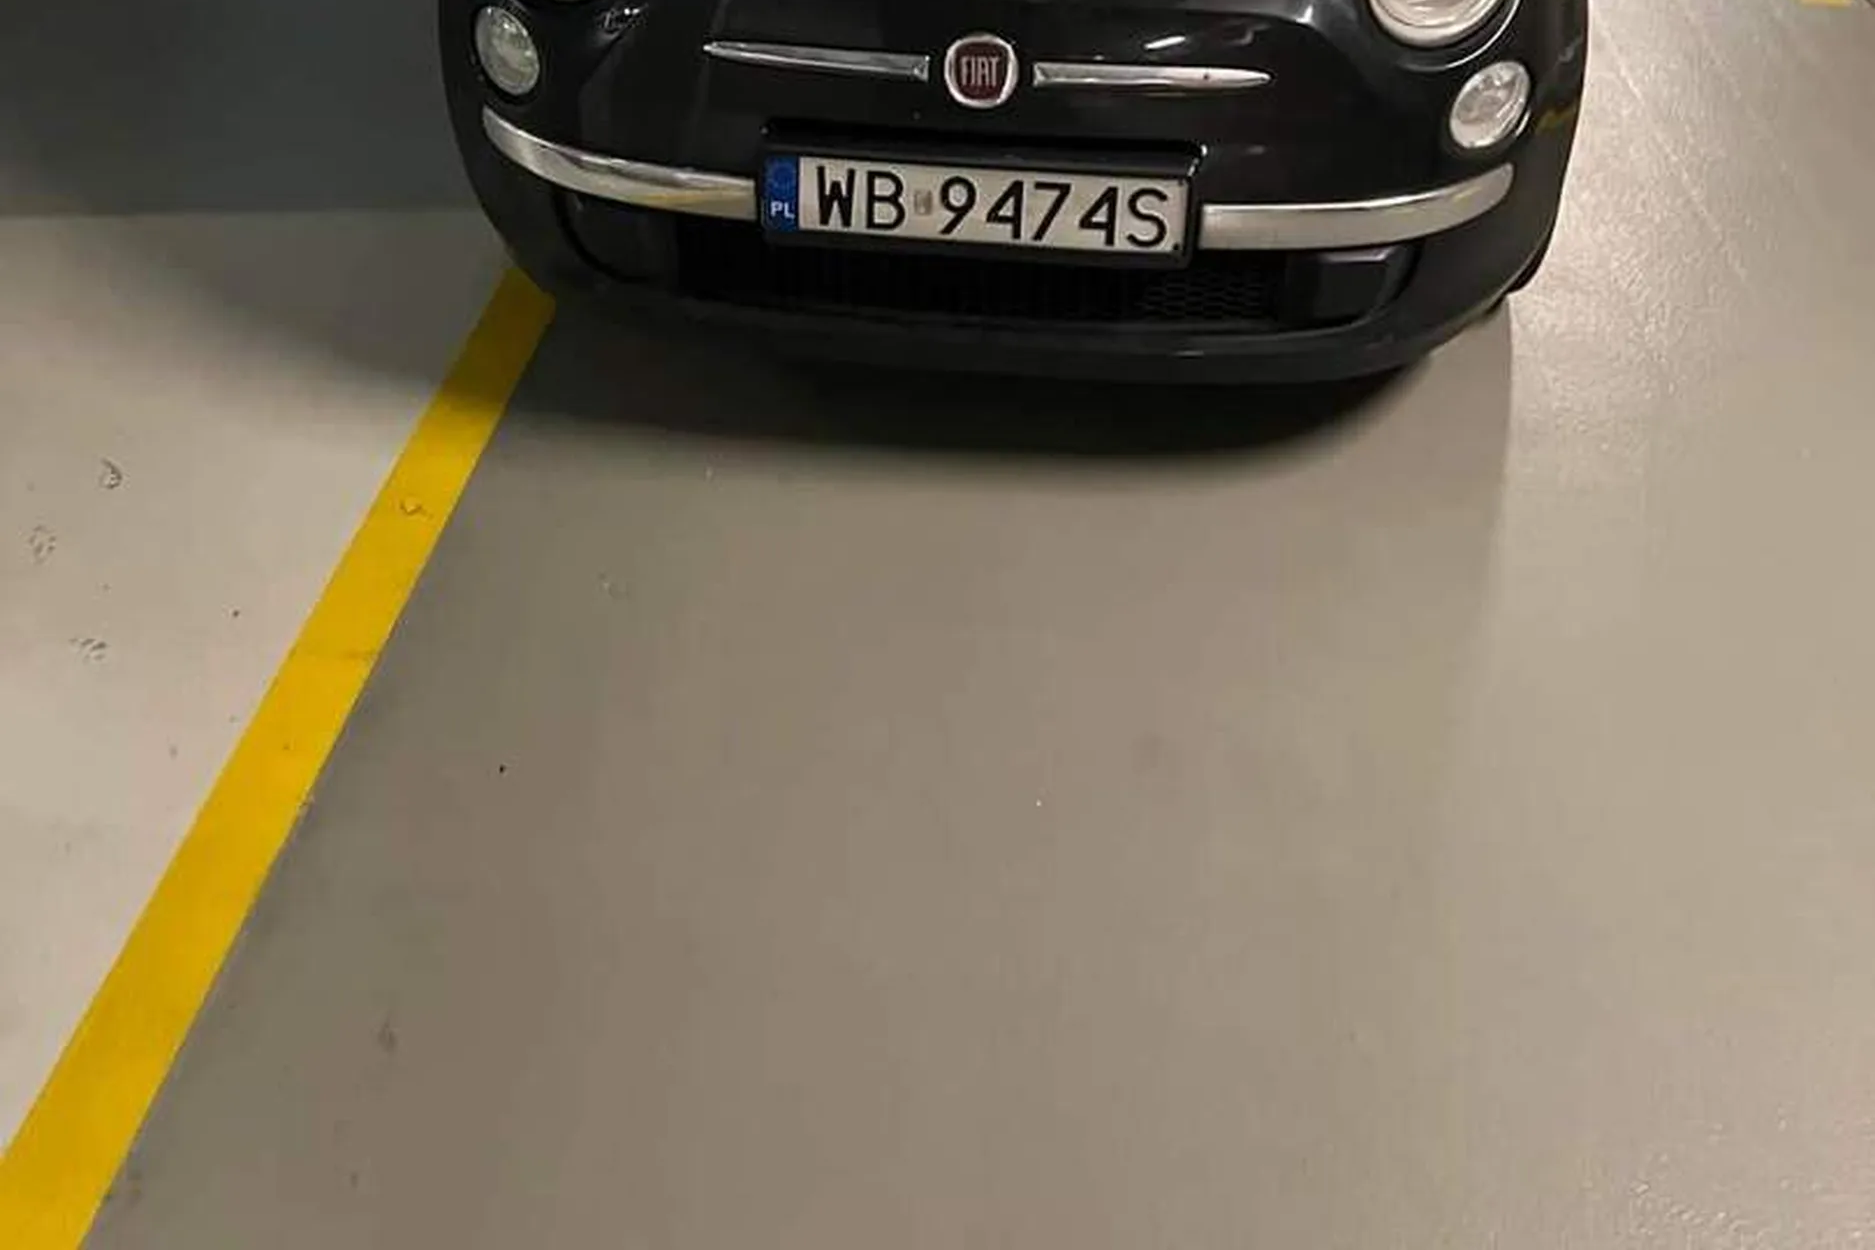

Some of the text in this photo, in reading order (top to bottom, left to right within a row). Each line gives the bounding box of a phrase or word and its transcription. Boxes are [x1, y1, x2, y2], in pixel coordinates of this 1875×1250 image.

[960, 55, 1000, 87] FIAT
[770, 164, 1169, 248] PL WB 9474S
